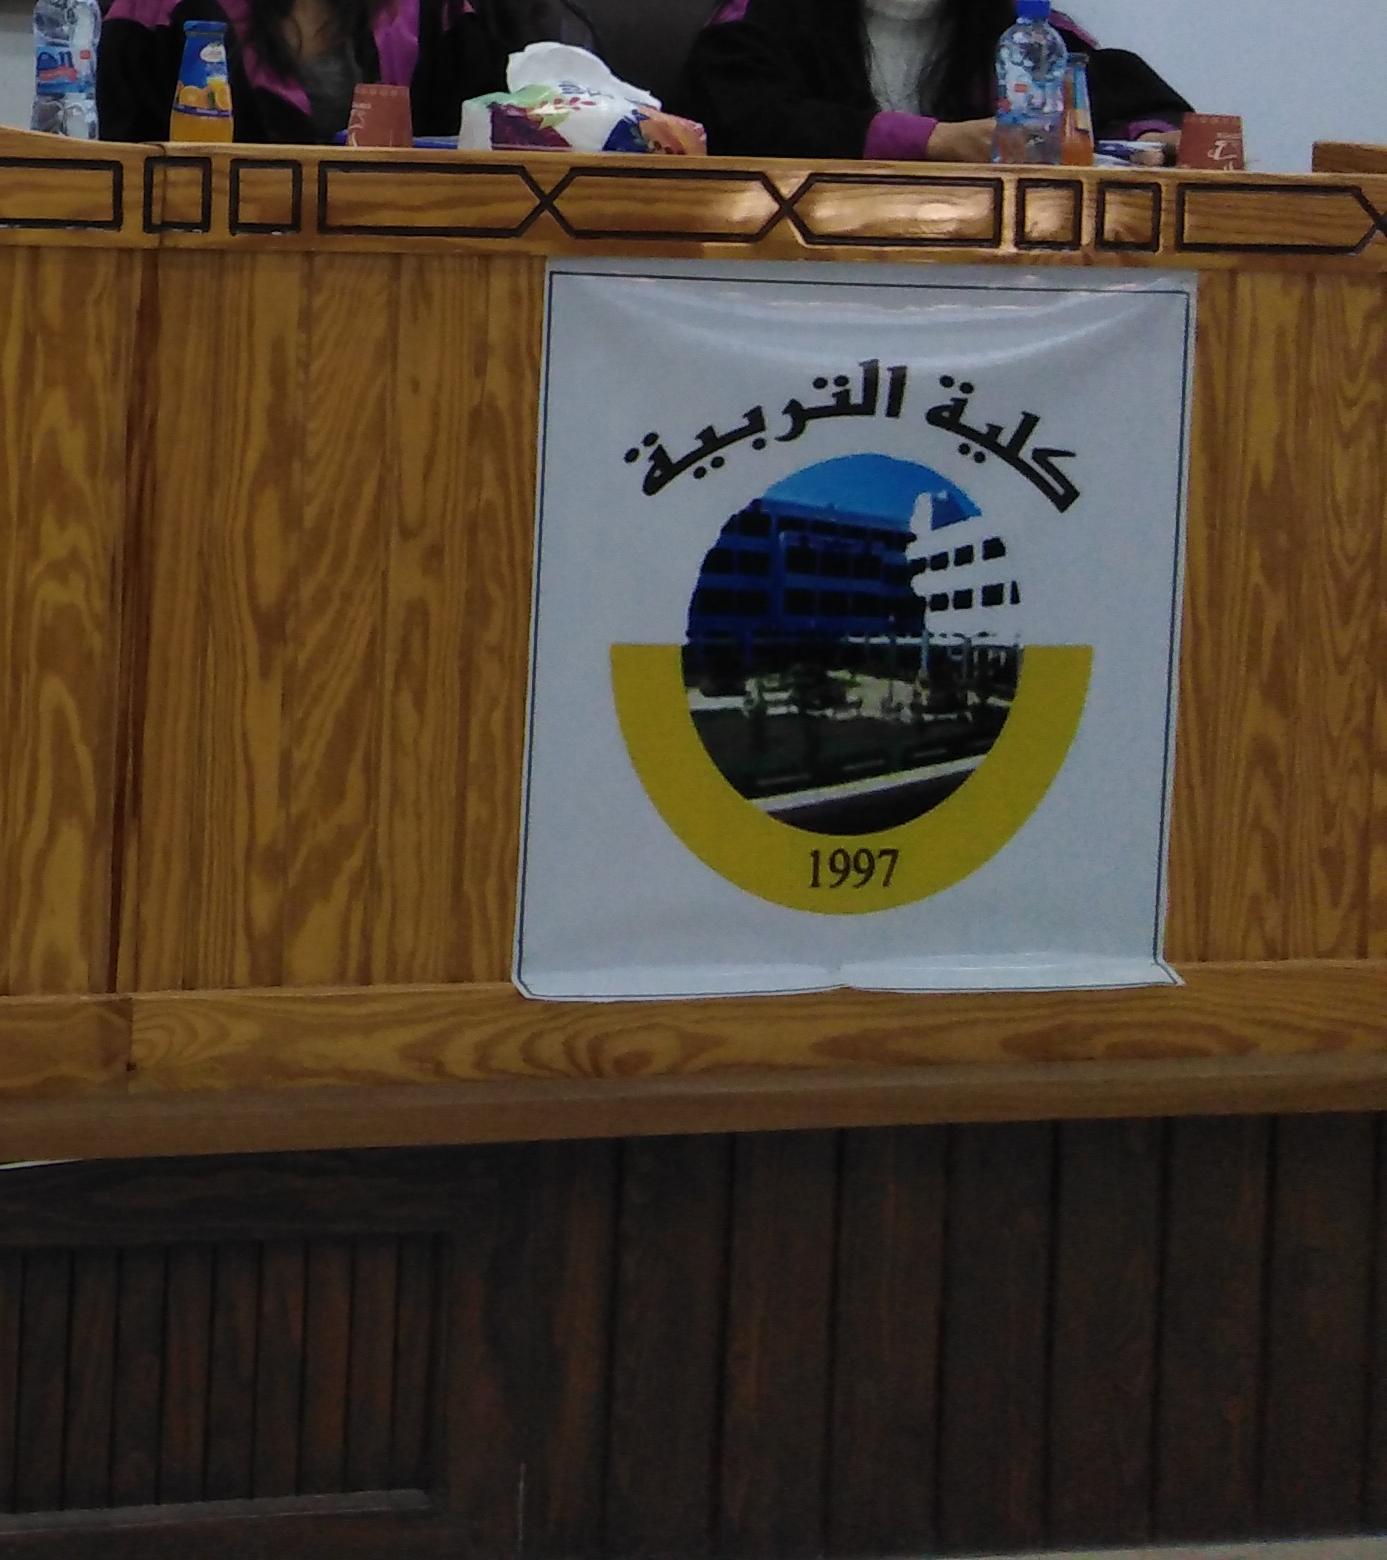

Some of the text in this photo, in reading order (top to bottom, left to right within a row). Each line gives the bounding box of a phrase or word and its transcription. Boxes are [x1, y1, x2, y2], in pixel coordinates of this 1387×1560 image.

[624, 359, 1080, 513] كلية التربية
[807, 848, 900, 889] 1997
